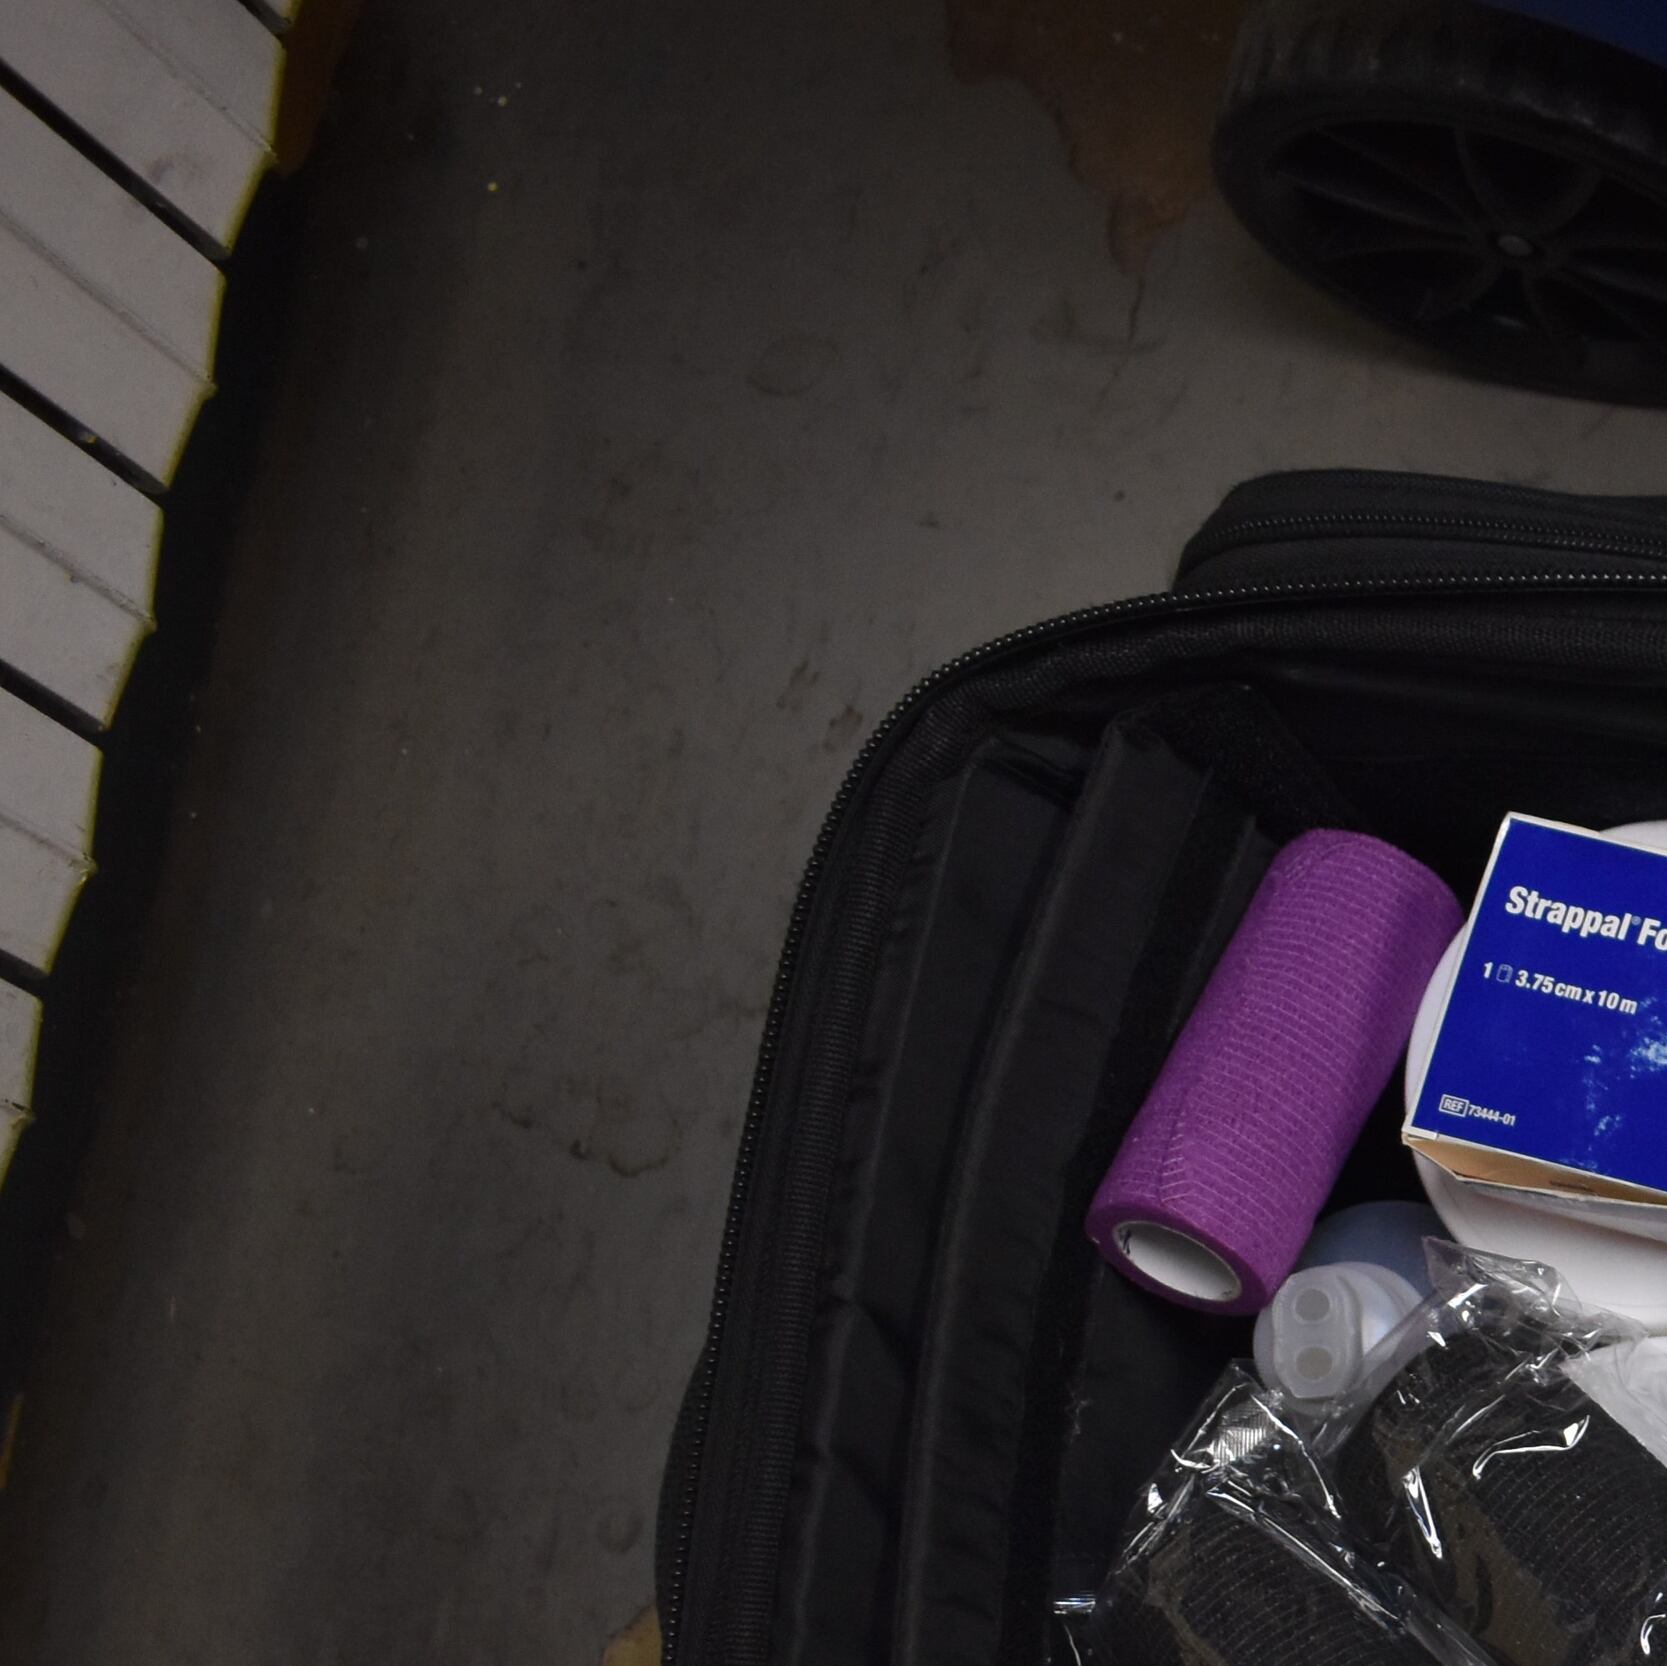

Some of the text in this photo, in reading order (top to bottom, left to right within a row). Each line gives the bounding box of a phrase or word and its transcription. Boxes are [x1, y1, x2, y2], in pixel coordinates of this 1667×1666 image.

[1483, 962, 1638, 1014] 1 3.75 cm x 10 m
[1443, 1097, 1516, 1126] REF 73444-01
